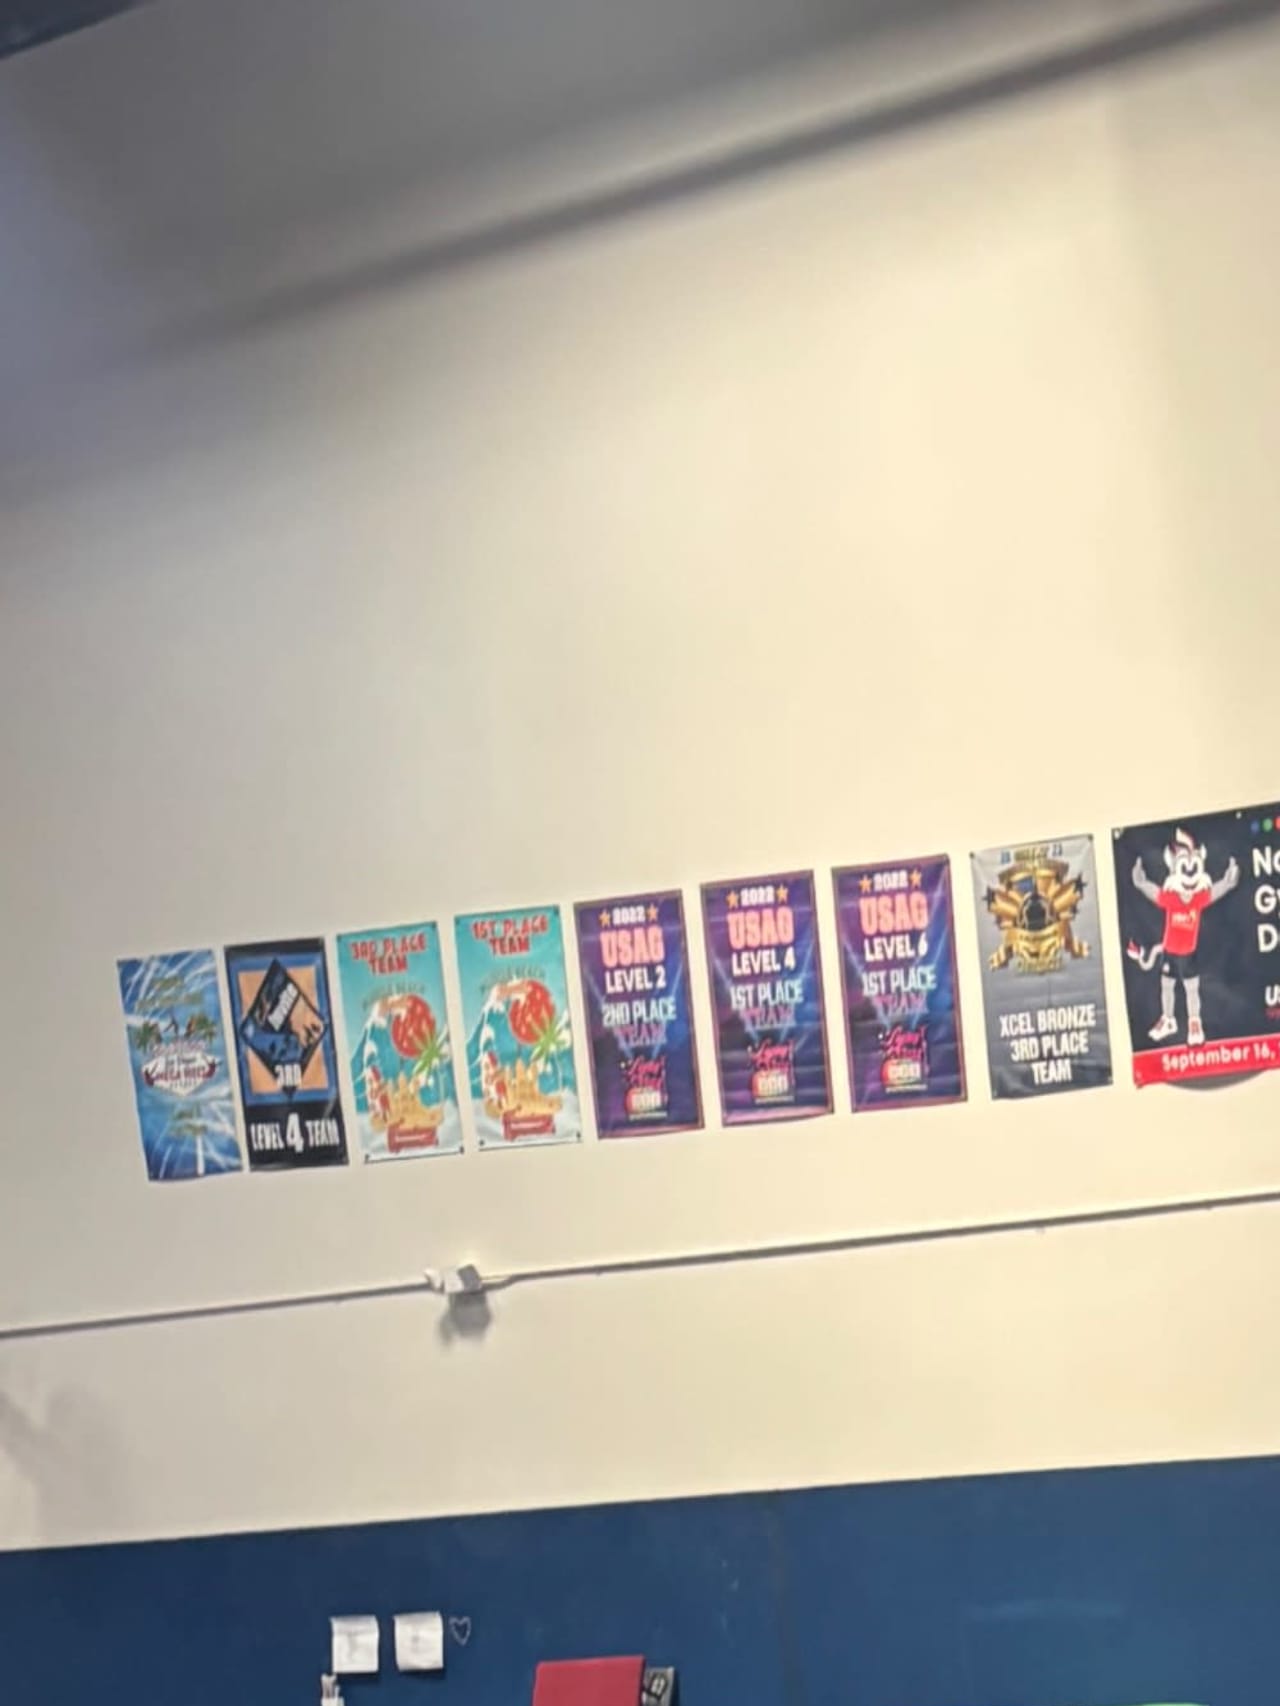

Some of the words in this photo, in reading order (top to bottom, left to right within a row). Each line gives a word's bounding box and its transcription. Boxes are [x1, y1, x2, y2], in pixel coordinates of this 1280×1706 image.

[503, 914, 547, 935] PLACE
[859, 891, 928, 935] USAG
[727, 907, 795, 949] USAG
[383, 932, 426, 954] PLACE
[489, 936, 530, 956] TEAM
[600, 926, 664, 968] USAG
[864, 936, 915, 962] LEVEL
[918, 933, 928, 957] 6
[368, 954, 408, 975] TEAM
[732, 951, 780, 976] LEVEL
[784, 947, 795, 970] 4
[605, 968, 653, 994] LEVEL
[655, 966, 666, 988] 2
[730, 985, 755, 1010] 1ST
[757, 979, 803, 1006] PLACE
[861, 971, 887, 996] 1ST
[890, 965, 936, 993] PLACE
[602, 1002, 630, 1027] 2ND
[633, 997, 676, 1024] PLACE
[1000, 1012, 1033, 1037] XCEL
[1037, 1004, 1096, 1032] BRONZE
[615, 1021, 668, 1048] TEAM
[1010, 1036, 1039, 1061] 3RD
[1042, 1031, 1089, 1057] PLACE
[1031, 1060, 1072, 1085] TEAM
[1162, 1048, 1250, 1072] September
[275, 1064, 303, 1088] 3RD
[250, 1121, 285, 1150] LEVEL
[286, 1113, 303, 1153] 4
[305, 1119, 341, 1147] TEAM
